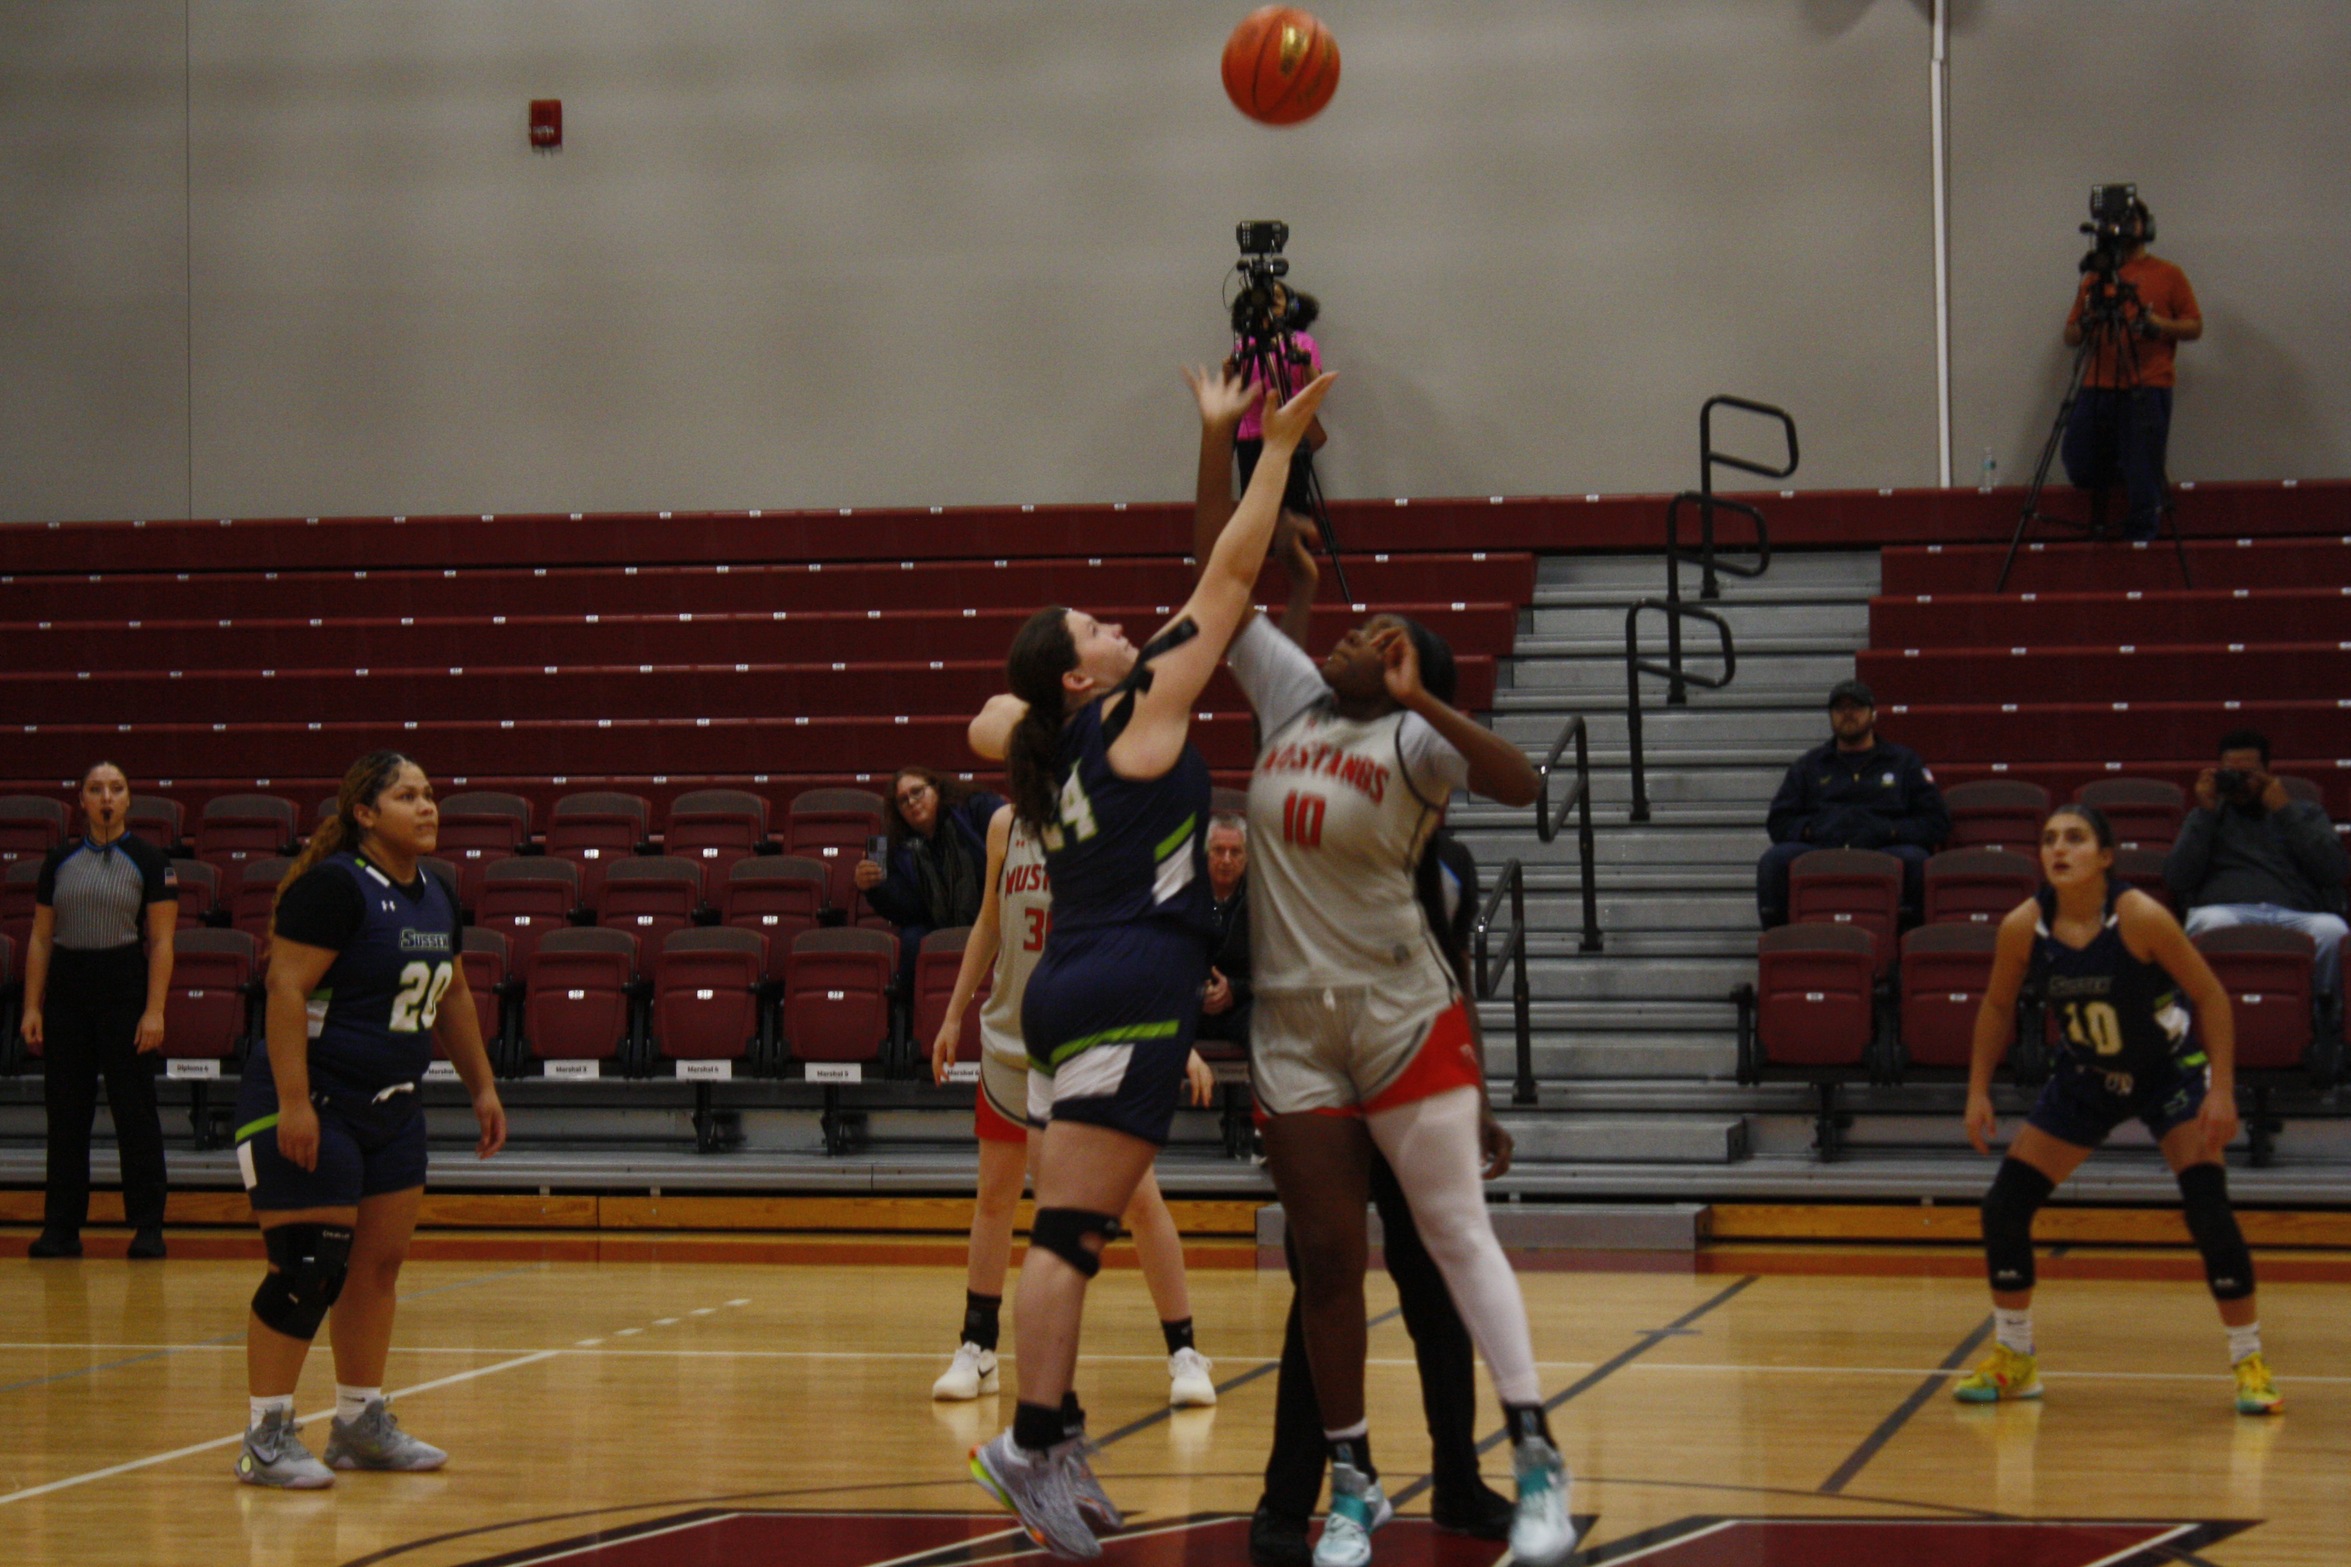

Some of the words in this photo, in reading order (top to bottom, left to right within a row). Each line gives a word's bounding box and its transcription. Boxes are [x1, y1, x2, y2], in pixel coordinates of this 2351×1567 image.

[1041, 757, 1099, 852] 4
[1283, 788, 1326, 851] 10
[1023, 907, 1054, 953] 3
[388, 961, 454, 1032] 20
[2064, 1001, 2123, 1056] 10
